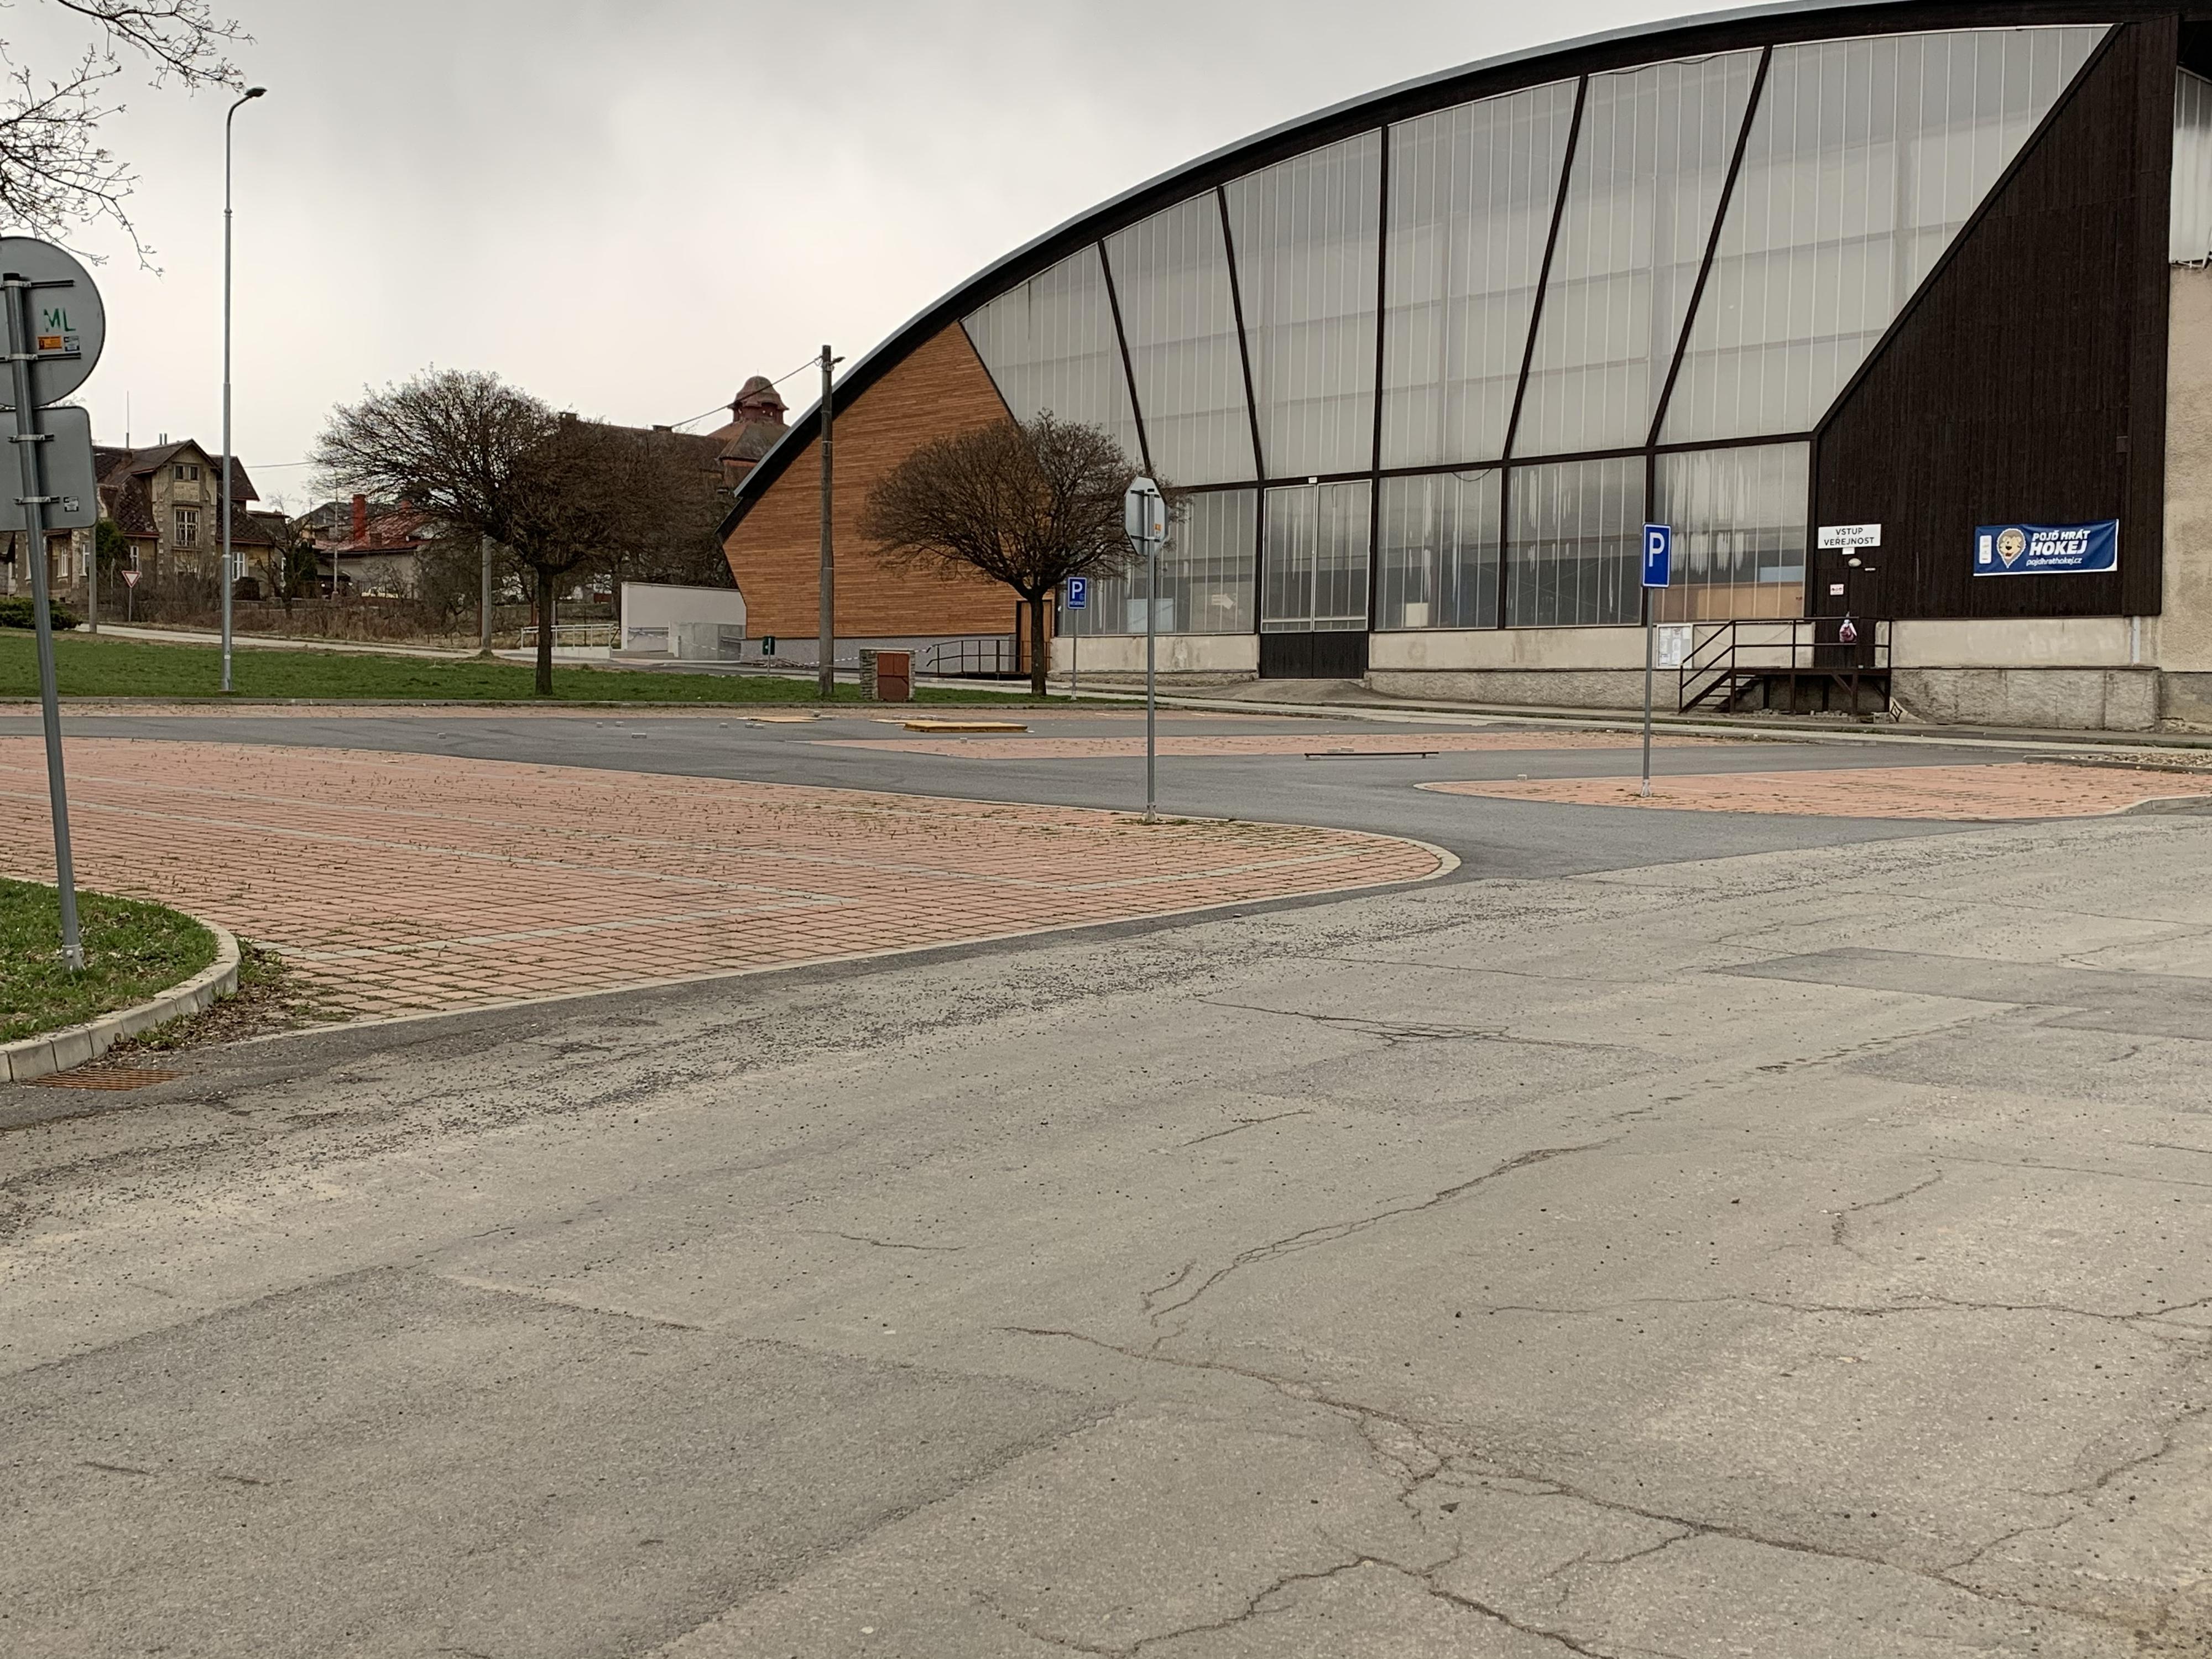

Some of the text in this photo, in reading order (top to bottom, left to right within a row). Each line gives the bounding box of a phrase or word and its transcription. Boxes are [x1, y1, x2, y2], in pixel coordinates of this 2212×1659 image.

[44, 307, 76, 332] ML
[1835, 527, 1863, 535] VSTUP
[2032, 529, 2090, 541] POJĎ HRÁT
[1824, 536, 1875, 546] VEŘEJNOST
[2029, 540, 2087, 556] HOKEJ
[1649, 532, 1665, 567] P
[1072, 581, 1083, 599] P
